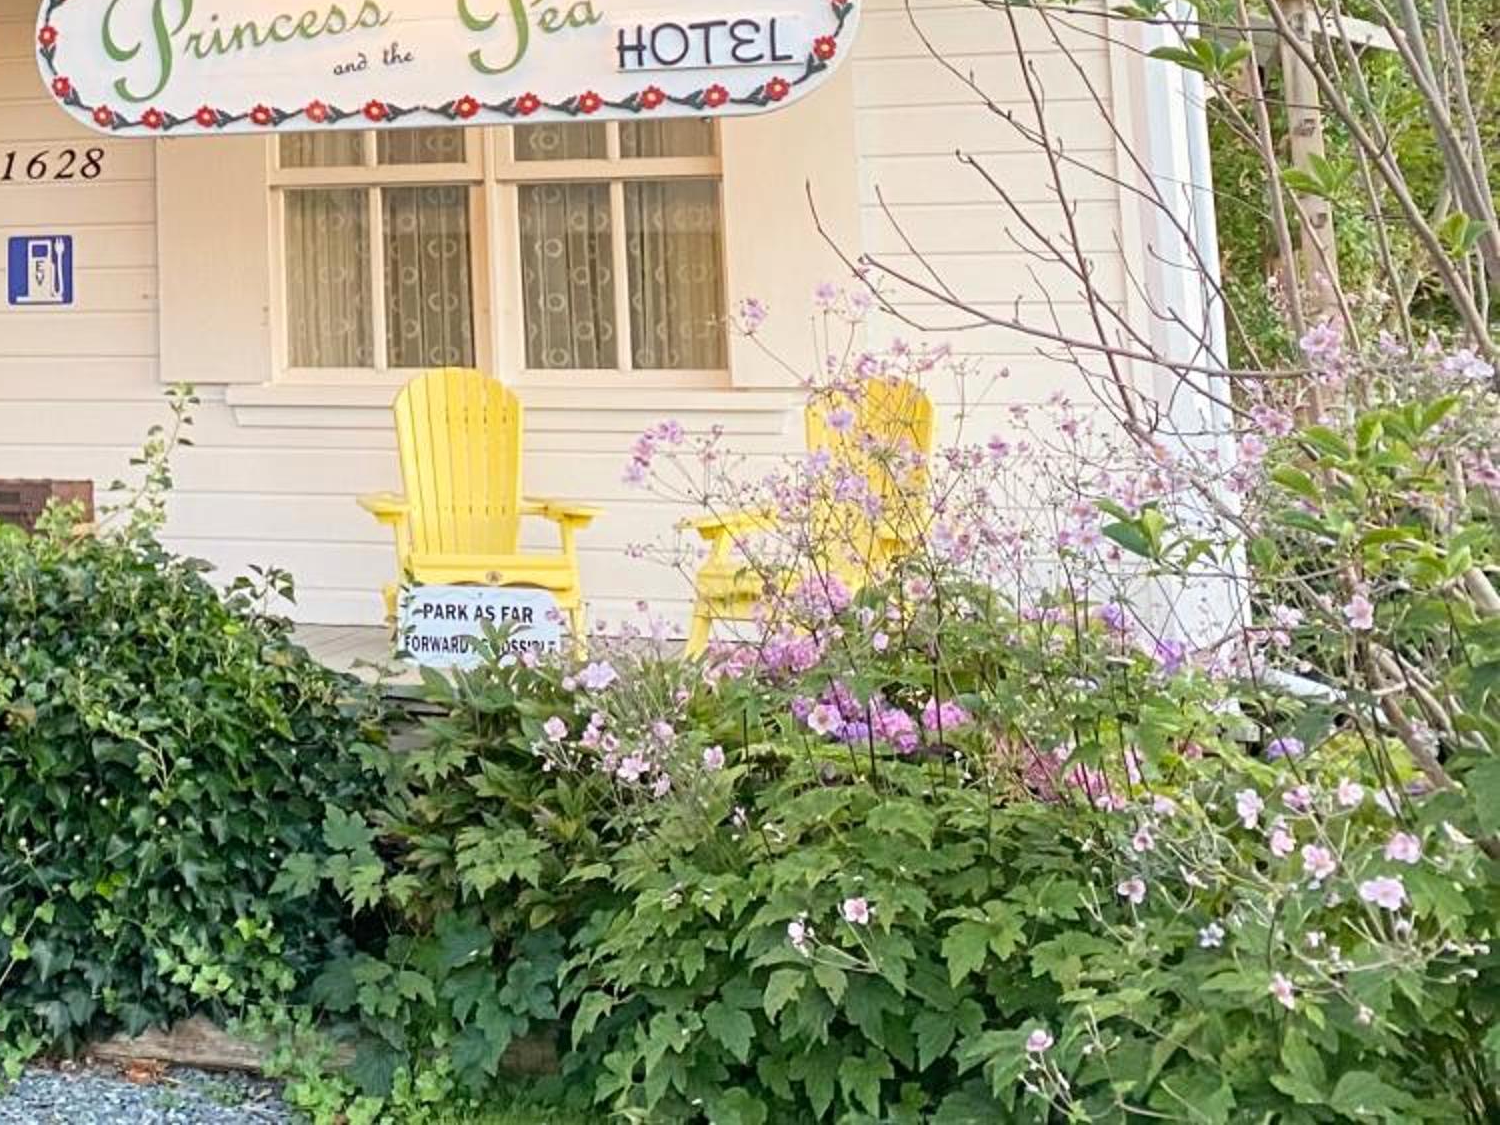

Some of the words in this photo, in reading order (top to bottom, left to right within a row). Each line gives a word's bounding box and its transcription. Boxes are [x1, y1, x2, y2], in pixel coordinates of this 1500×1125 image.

[615, 18, 793, 68] HOTEL
[332, 52, 369, 76] and
[382, 42, 414, 68] the
[423, 602, 468, 620] PARK
[474, 605, 495, 622] AS
[501, 606, 533, 624] FAR
[405, 635, 469, 654] FORWARD
[497, 638, 556, 655] OSSLE
